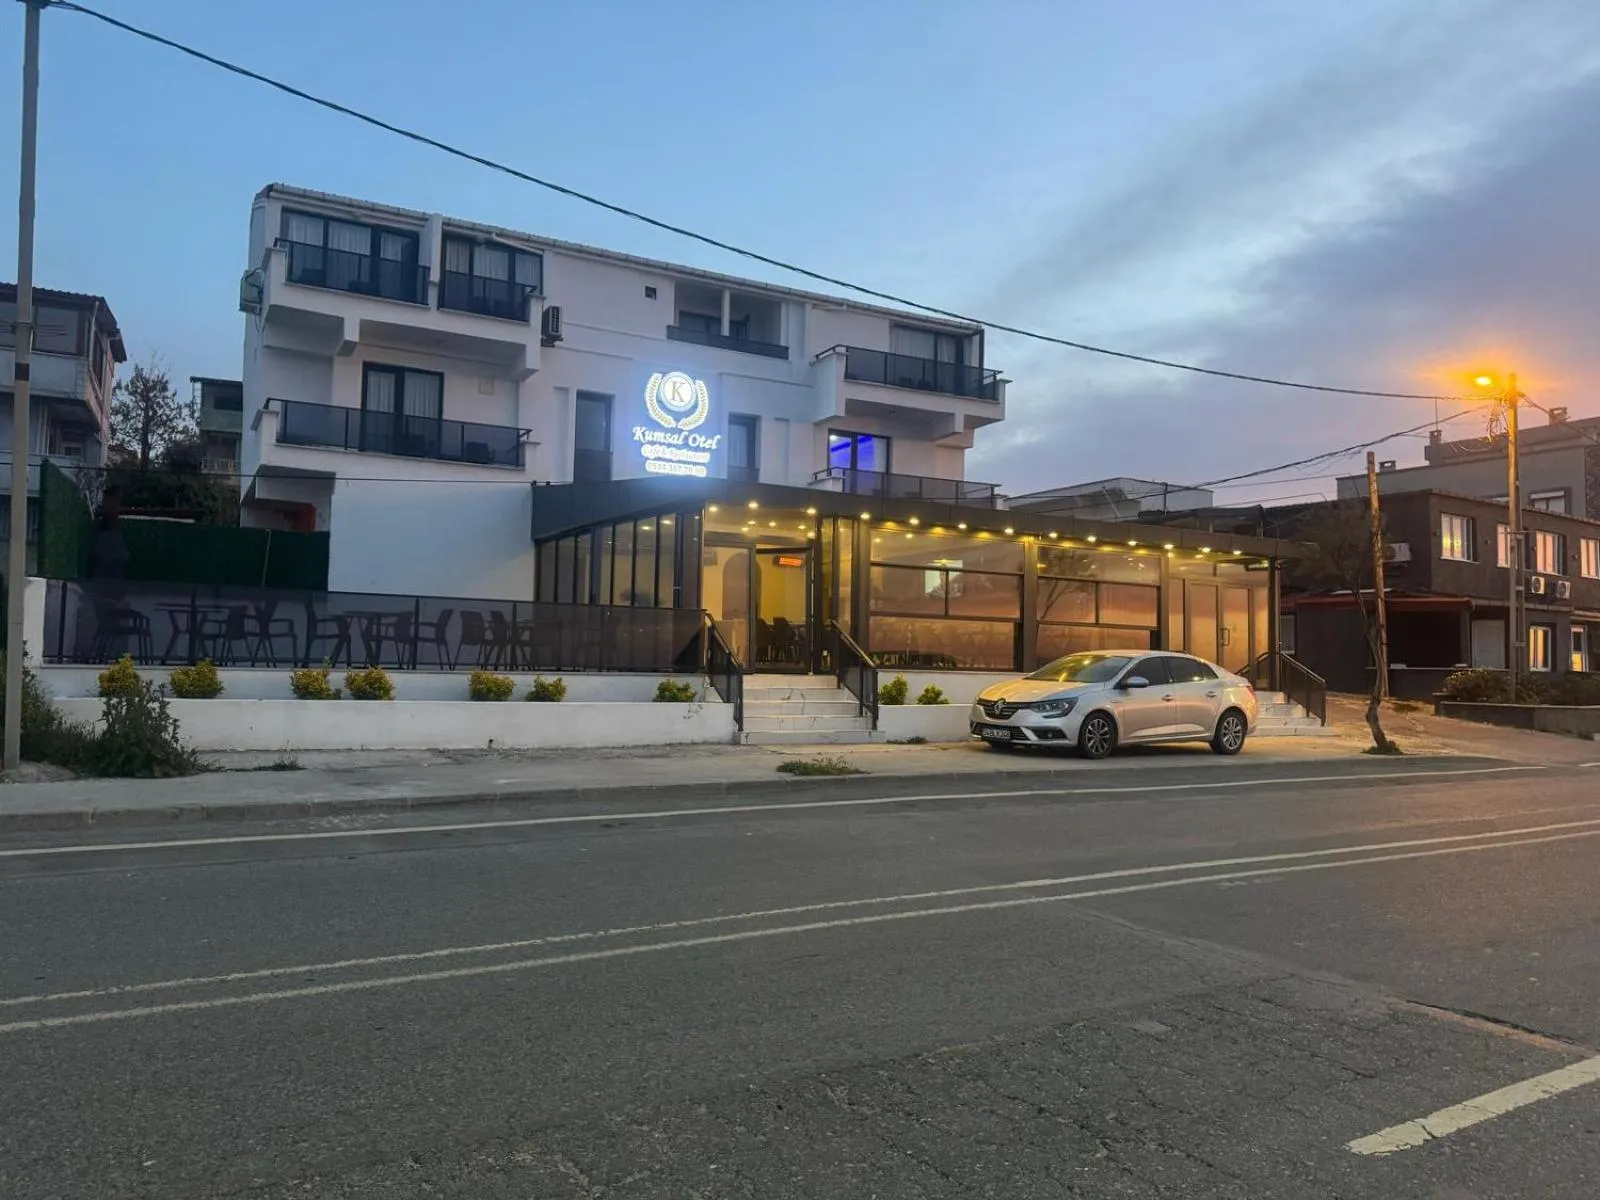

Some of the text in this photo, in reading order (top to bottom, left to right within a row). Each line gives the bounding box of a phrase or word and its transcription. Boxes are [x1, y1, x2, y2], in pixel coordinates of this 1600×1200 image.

[669, 381, 687, 403] K
[632, 426, 721, 449] Kumsal Otel
